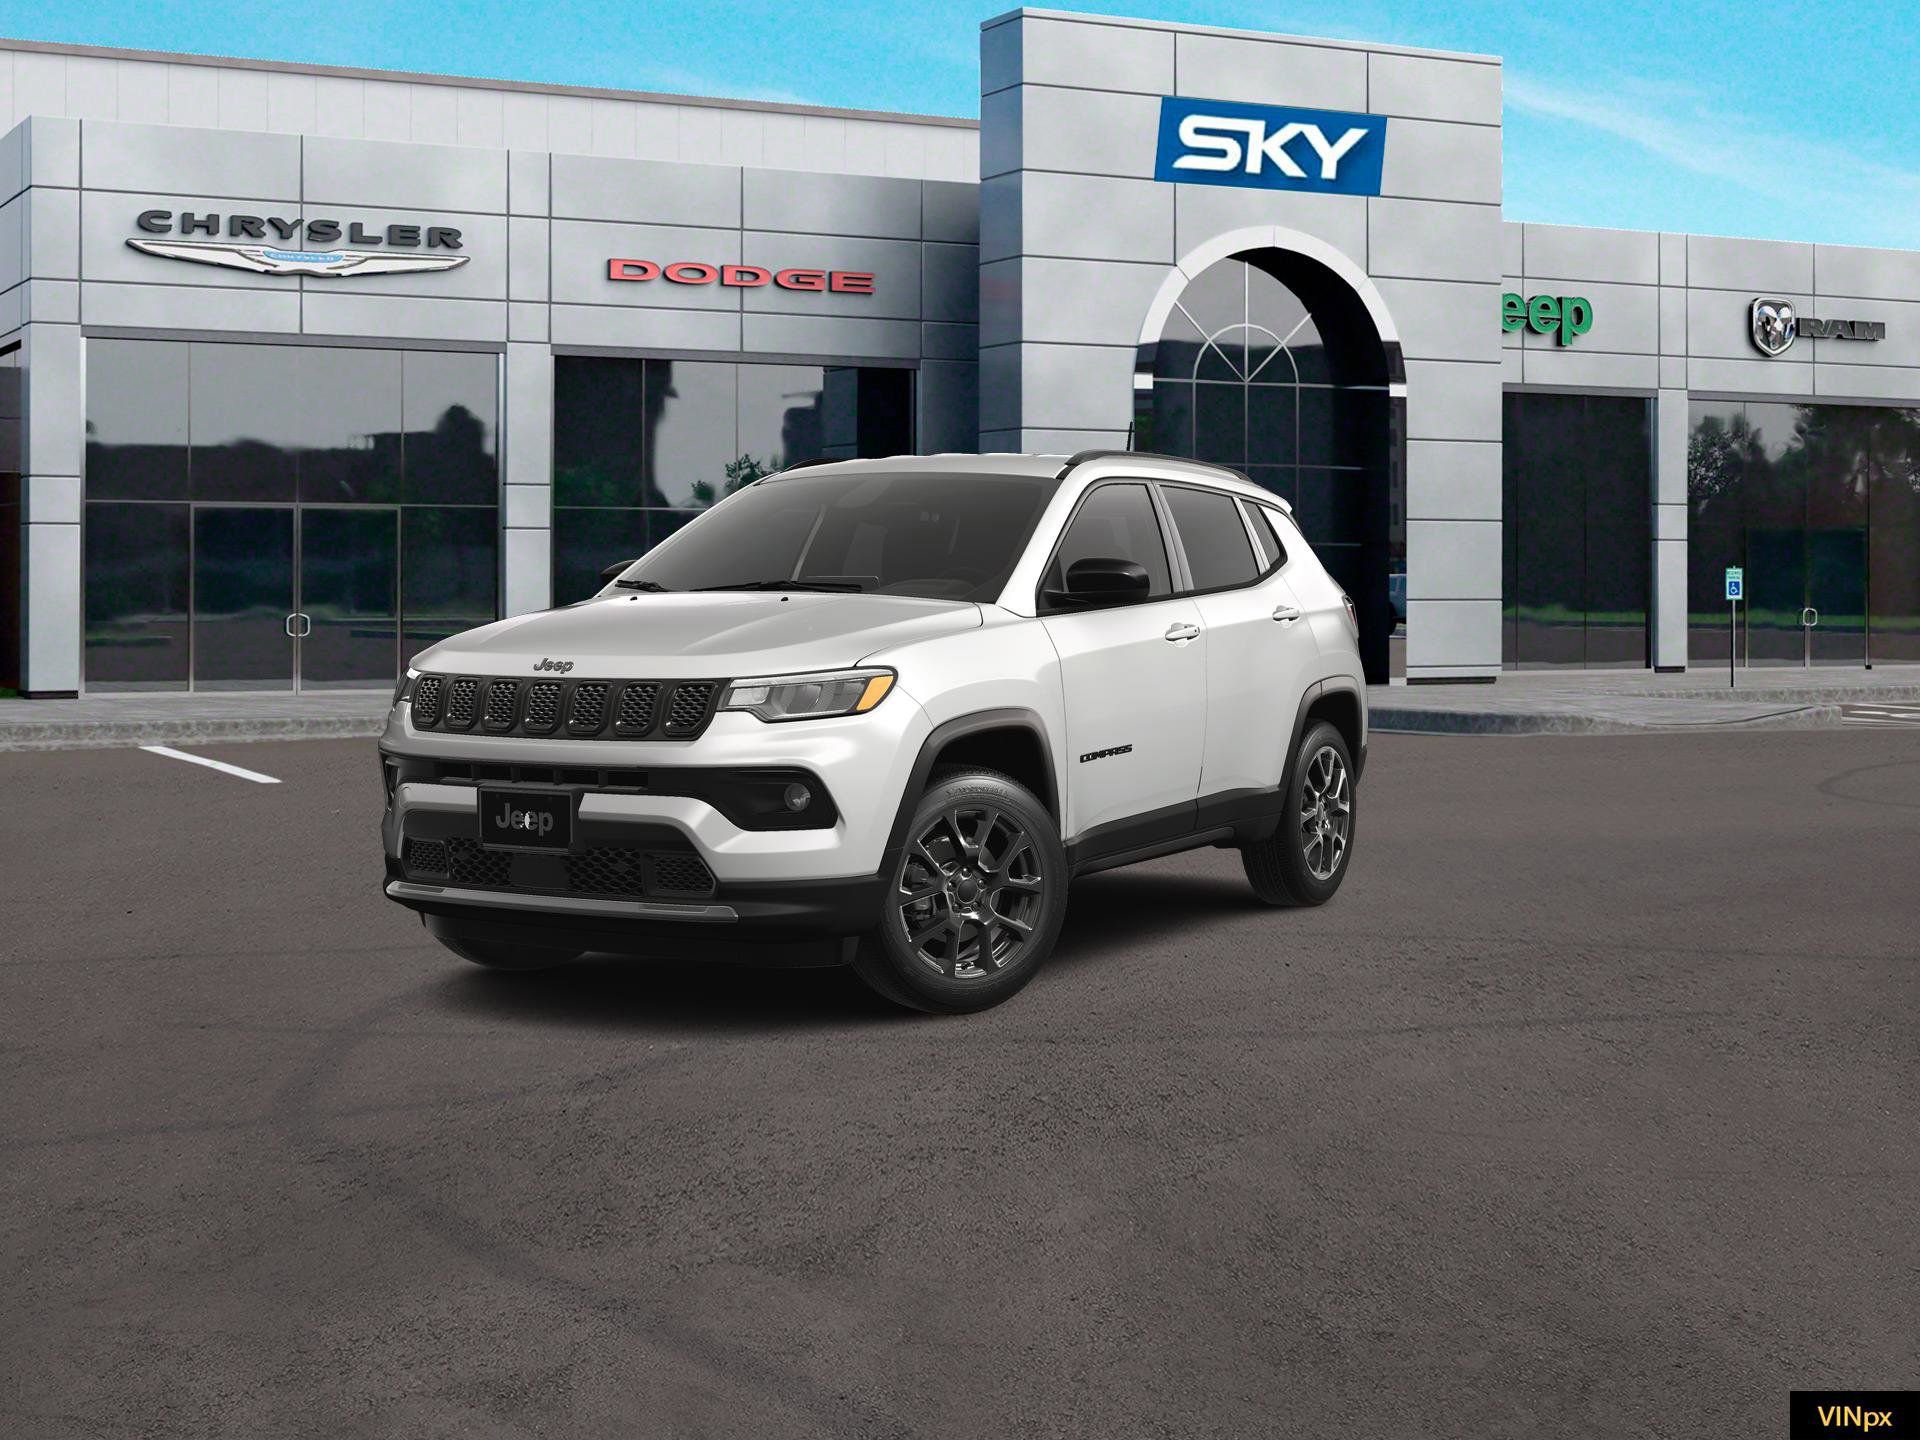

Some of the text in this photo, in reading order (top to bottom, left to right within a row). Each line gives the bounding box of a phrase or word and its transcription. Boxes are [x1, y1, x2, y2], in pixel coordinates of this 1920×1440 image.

[1172, 114, 1369, 180] SKY
[137, 209, 463, 249] CHRYSLER
[607, 258, 876, 294] DODGE
[1502, 293, 1593, 346] eep
[1796, 317, 1886, 340] RAM
[533, 657, 575, 674] Jeep
[495, 802, 554, 837] Jeep
